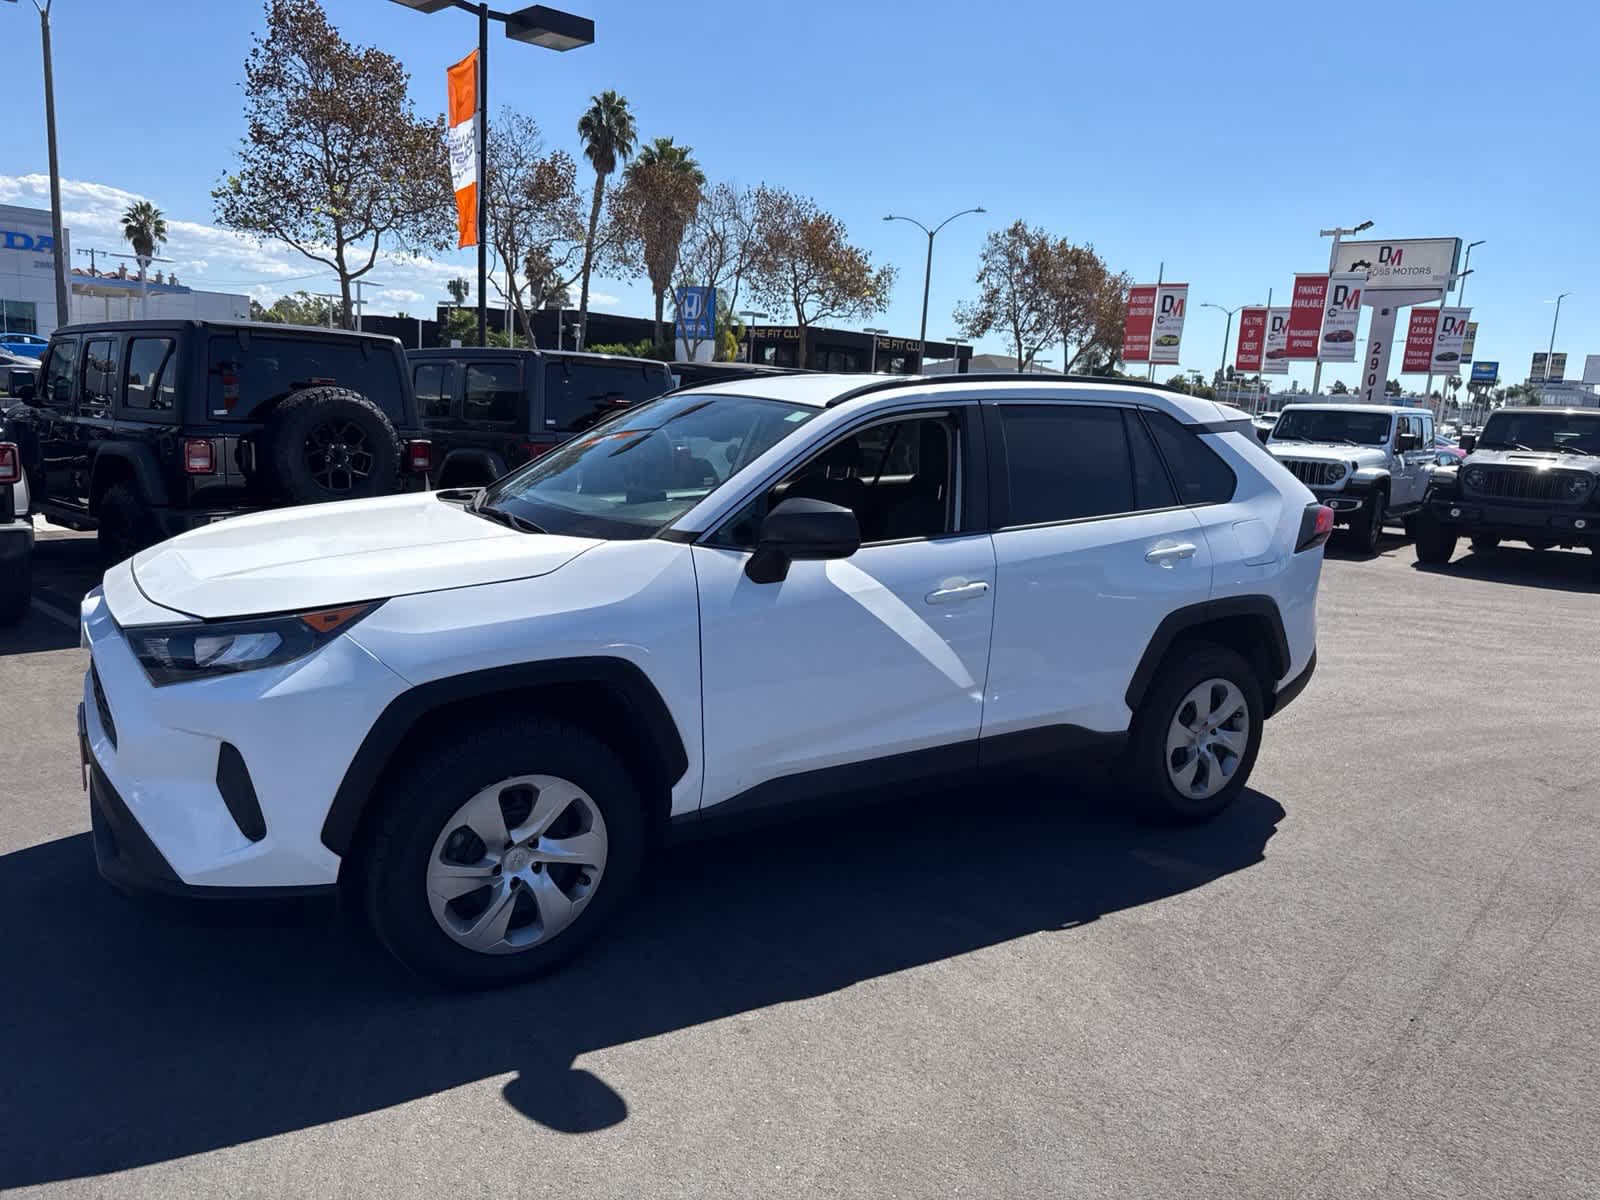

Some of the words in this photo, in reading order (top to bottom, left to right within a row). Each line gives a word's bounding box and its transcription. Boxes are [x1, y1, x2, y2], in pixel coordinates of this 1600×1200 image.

[1392, 266, 1432, 276] MOTORS
[1412, 316, 1422, 324] WE
[1423, 316, 1436, 324] BUY
[767, 329, 783, 339] FIT
[1411, 326, 1426, 334] CARS
[1409, 336, 1433, 345] TRUCKS
